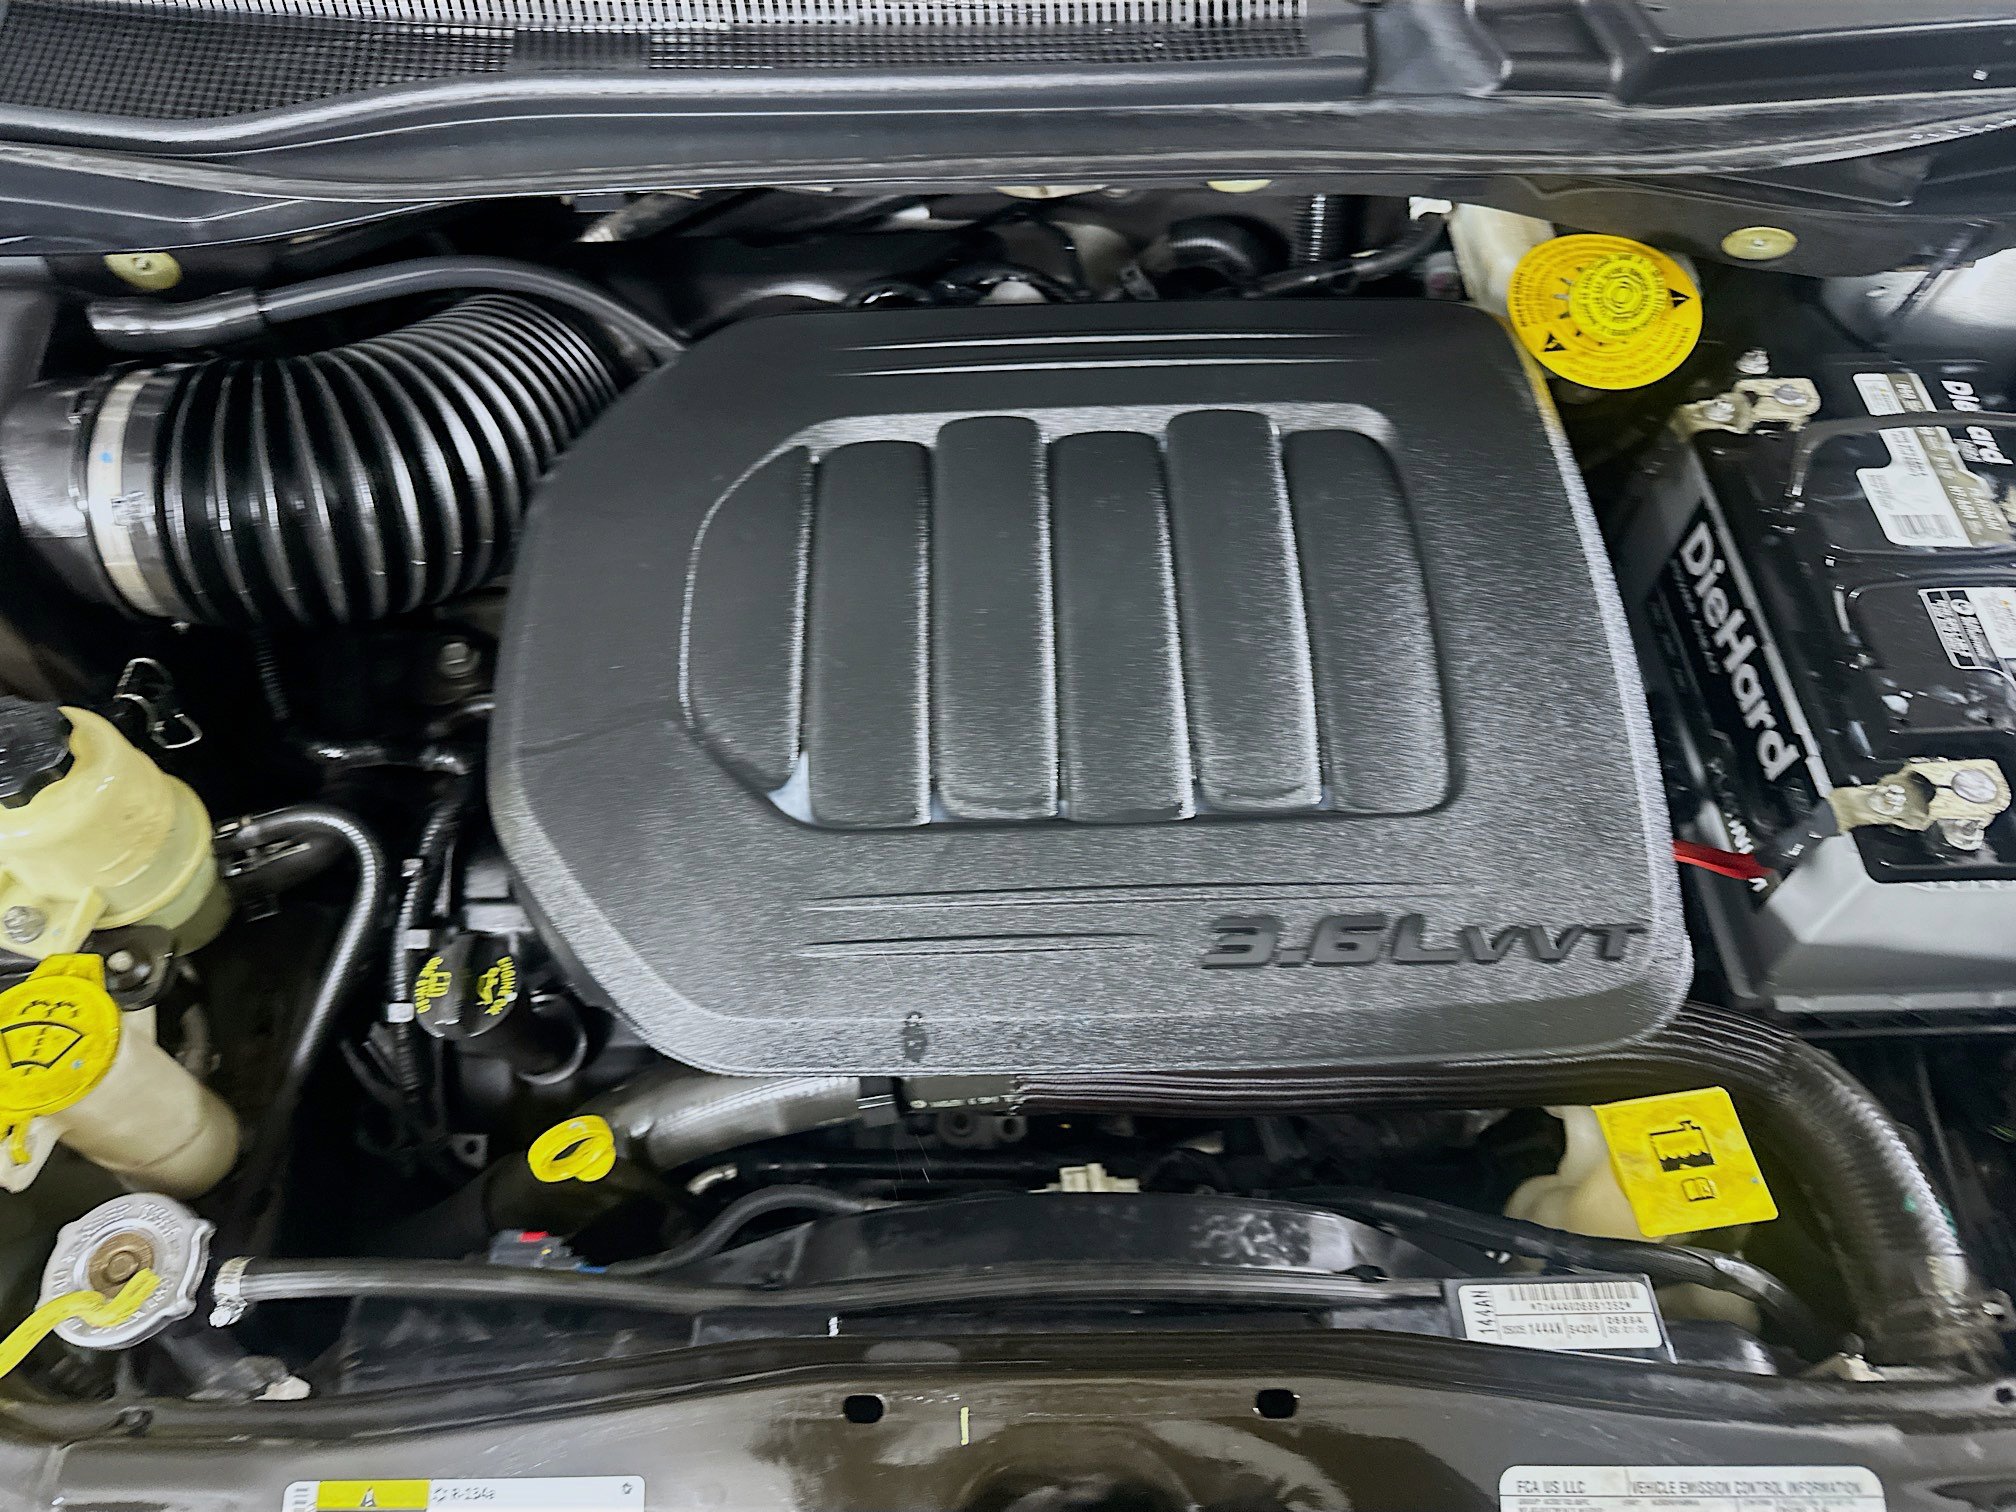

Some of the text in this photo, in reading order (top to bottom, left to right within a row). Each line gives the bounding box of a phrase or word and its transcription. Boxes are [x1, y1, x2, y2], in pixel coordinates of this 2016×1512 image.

[1941, 380, 2014, 465] Dieard
[1679, 520, 1800, 781] DieHard
[1517, 1480, 1586, 1494] FCA US LLC
